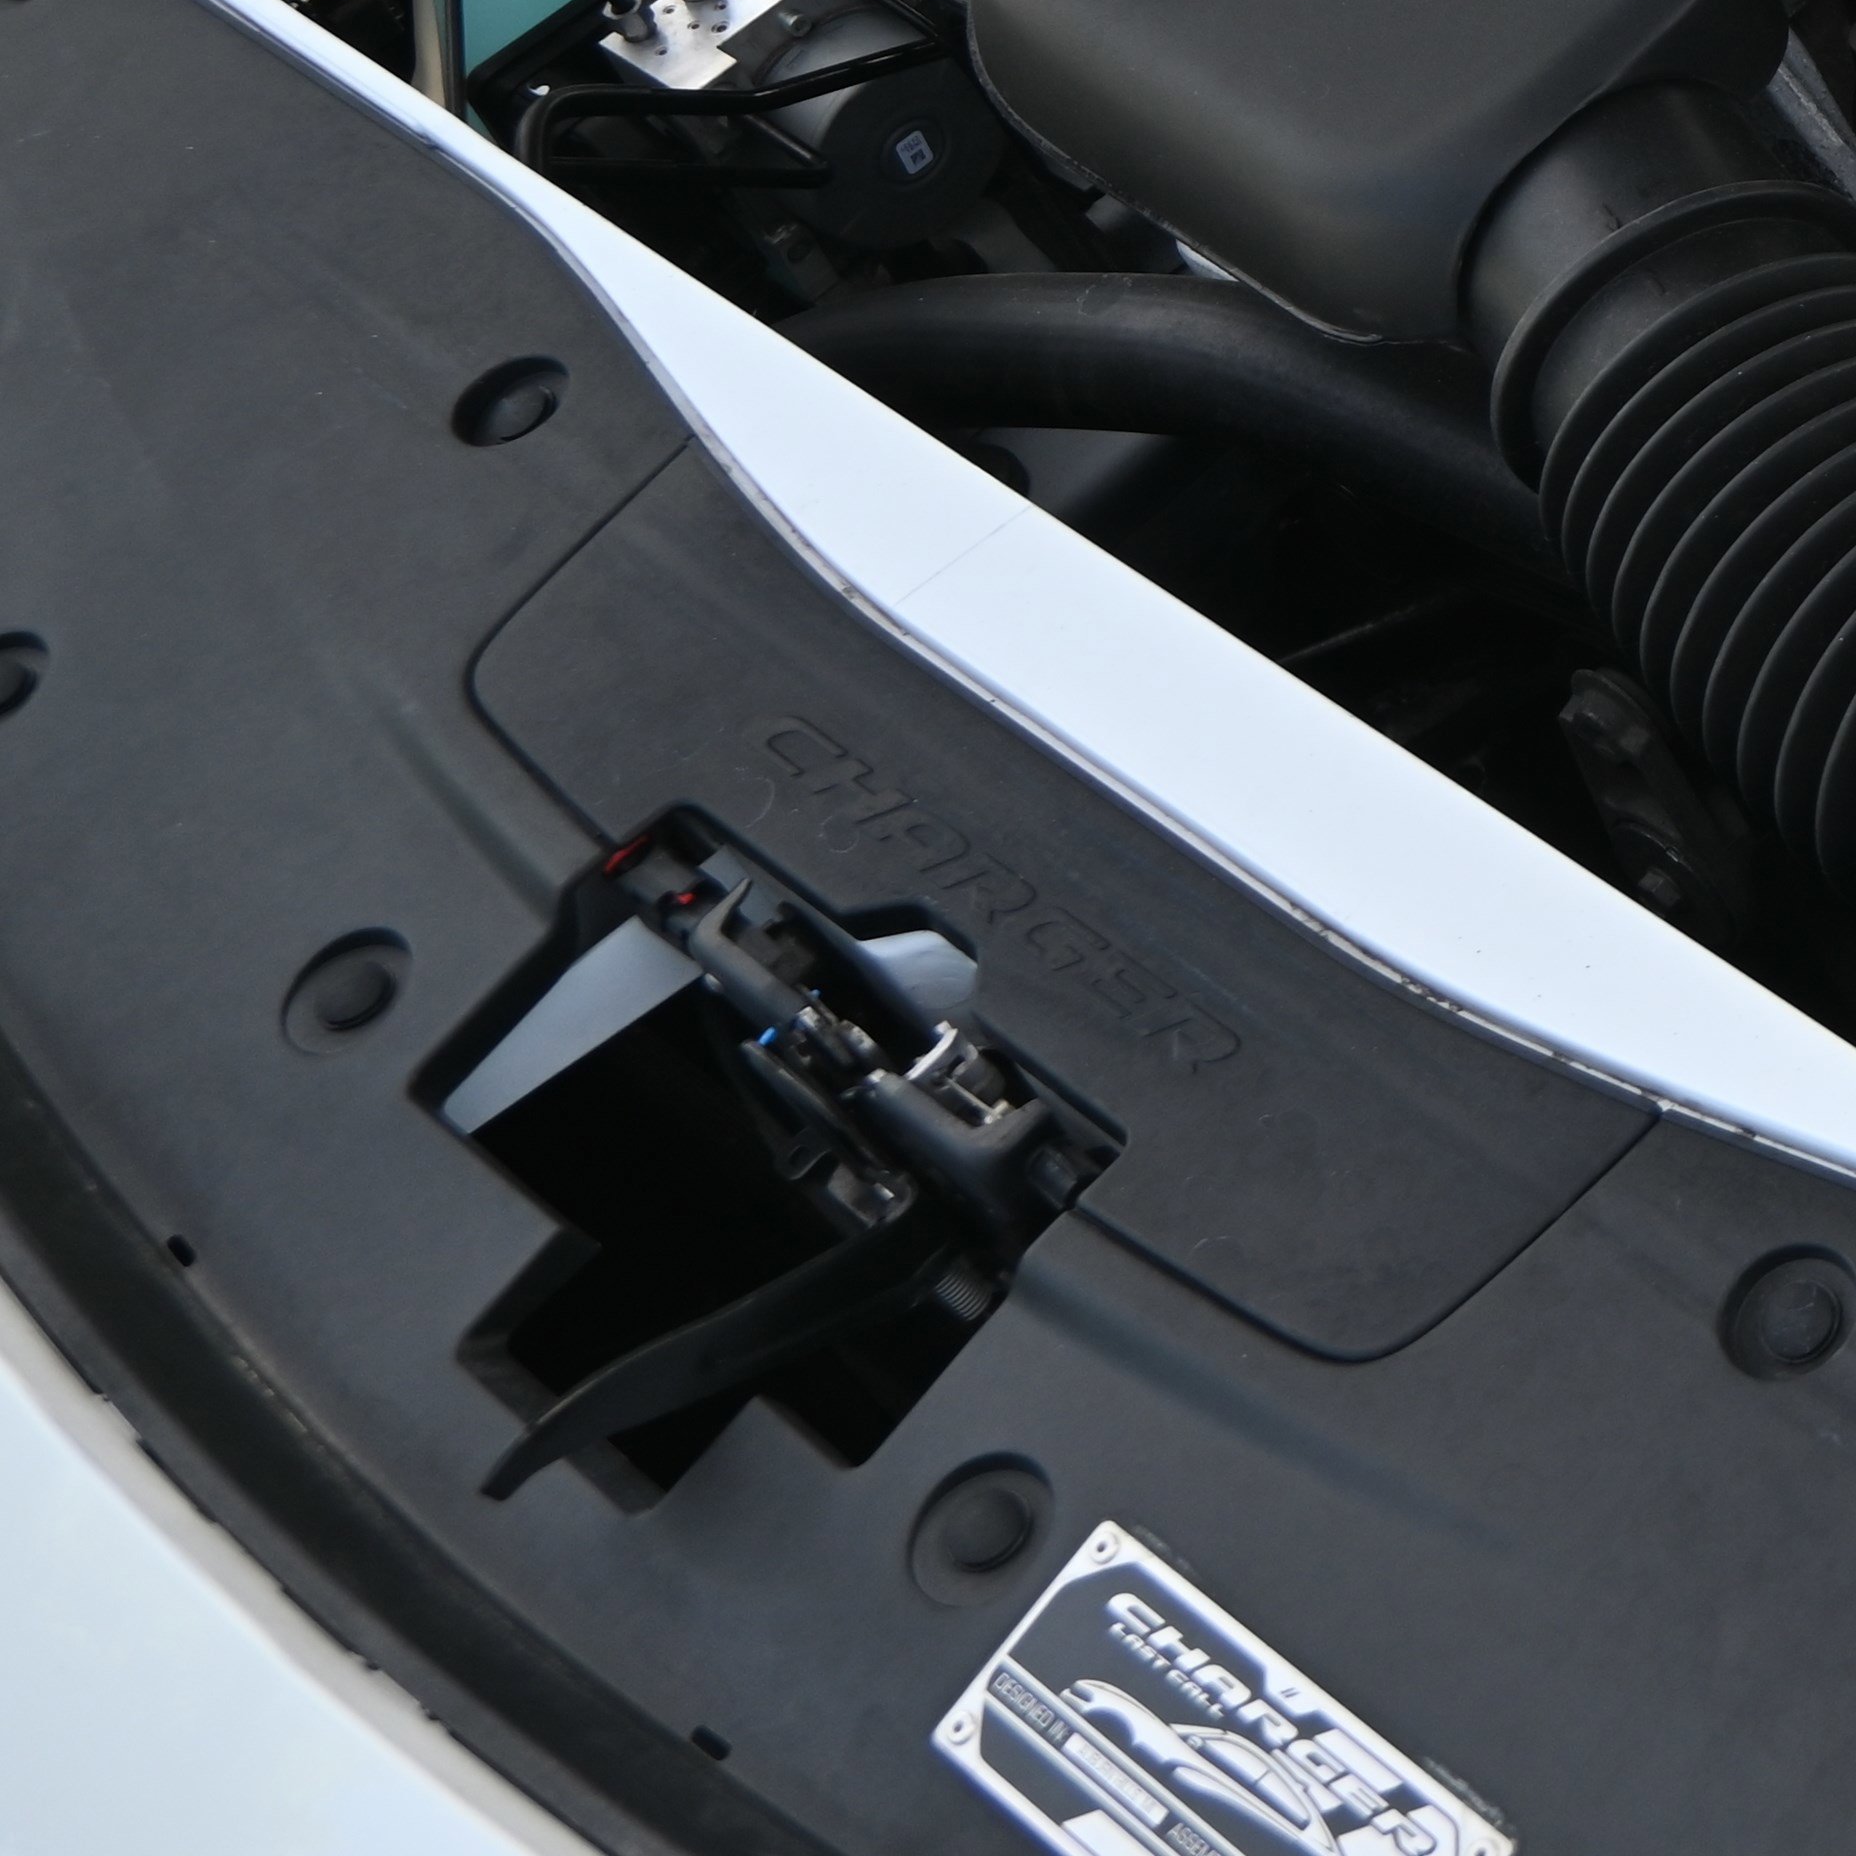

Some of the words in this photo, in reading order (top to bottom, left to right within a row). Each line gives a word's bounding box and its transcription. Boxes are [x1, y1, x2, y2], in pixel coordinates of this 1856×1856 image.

[760, 715, 1243, 1075] CHARGER
[992, 1672, 1053, 1727] DESIGNED
[1105, 1593, 1437, 1856] CHARGER
[1108, 1621, 1172, 1671] LAST
[1164, 1667, 1225, 1721] CALL
